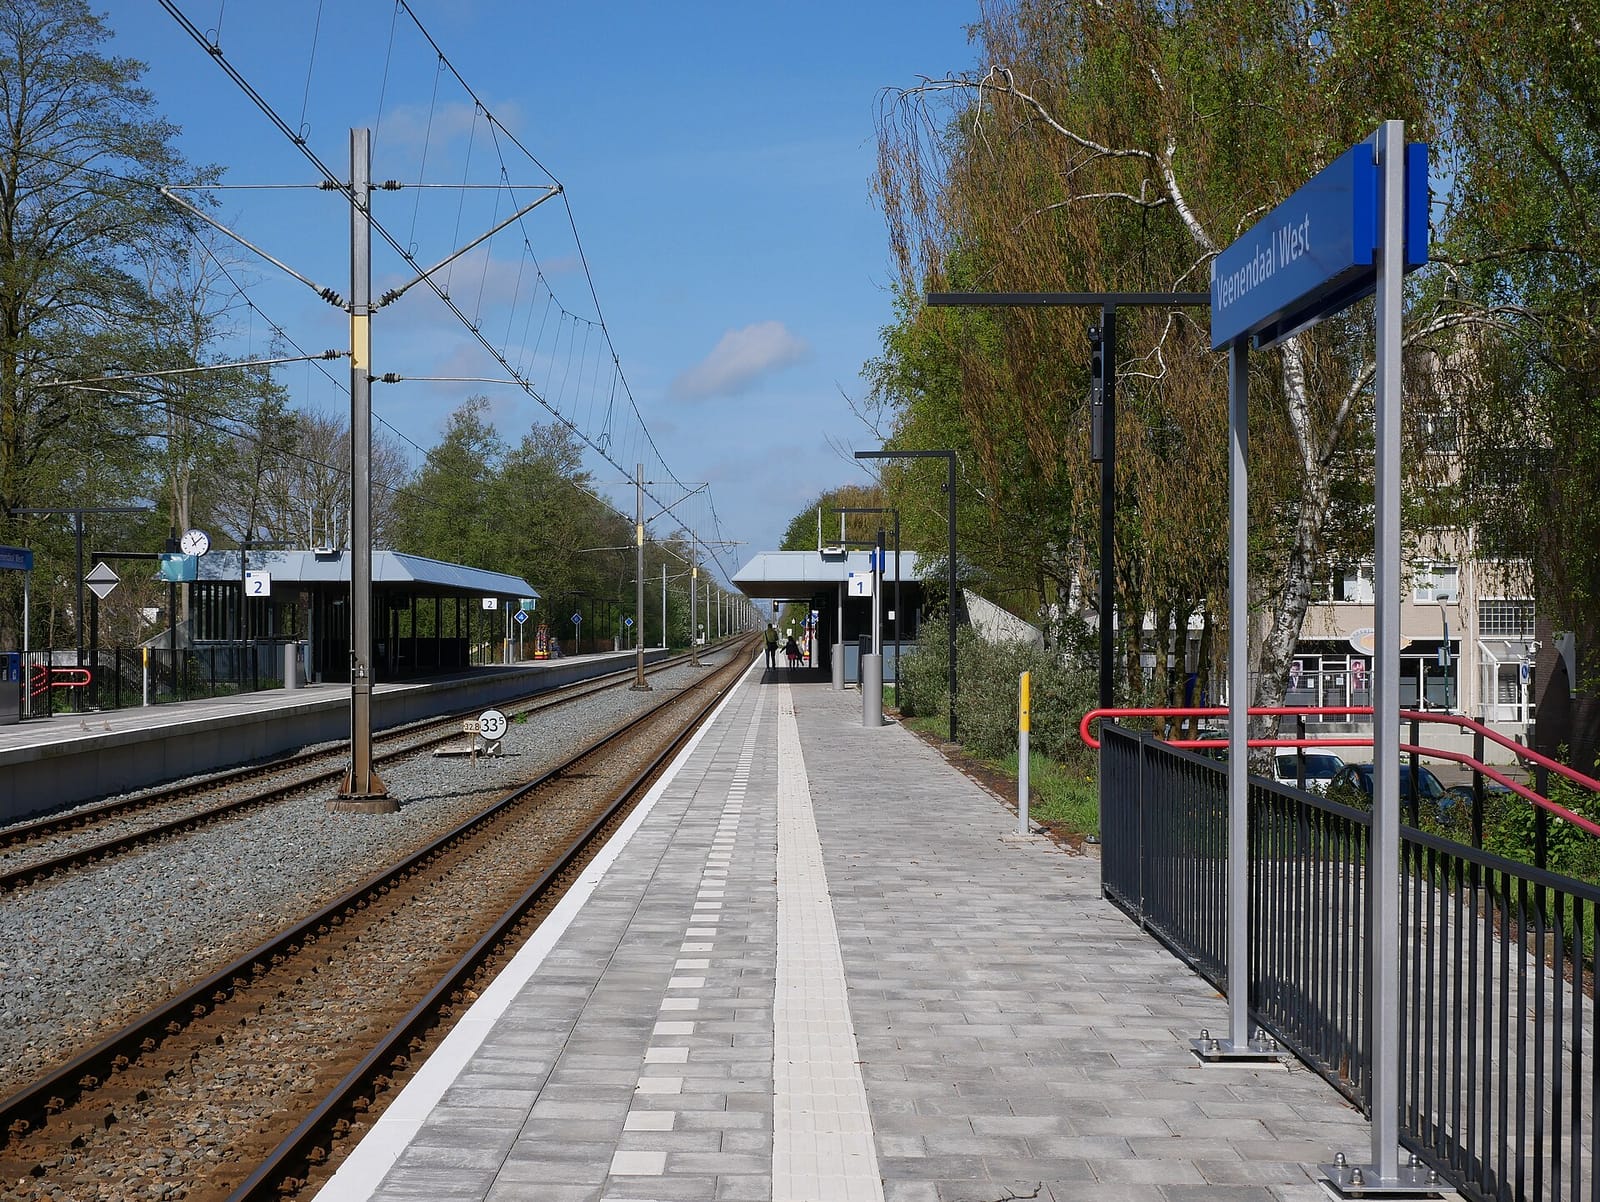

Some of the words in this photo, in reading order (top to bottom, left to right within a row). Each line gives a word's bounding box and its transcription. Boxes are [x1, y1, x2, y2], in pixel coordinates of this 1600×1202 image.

[1216, 231, 1276, 311] Veenendaal
[1279, 212, 1310, 268] West
[254, 581, 262, 593] 2
[857, 581, 863, 594] 1
[487, 600, 493, 608] 2
